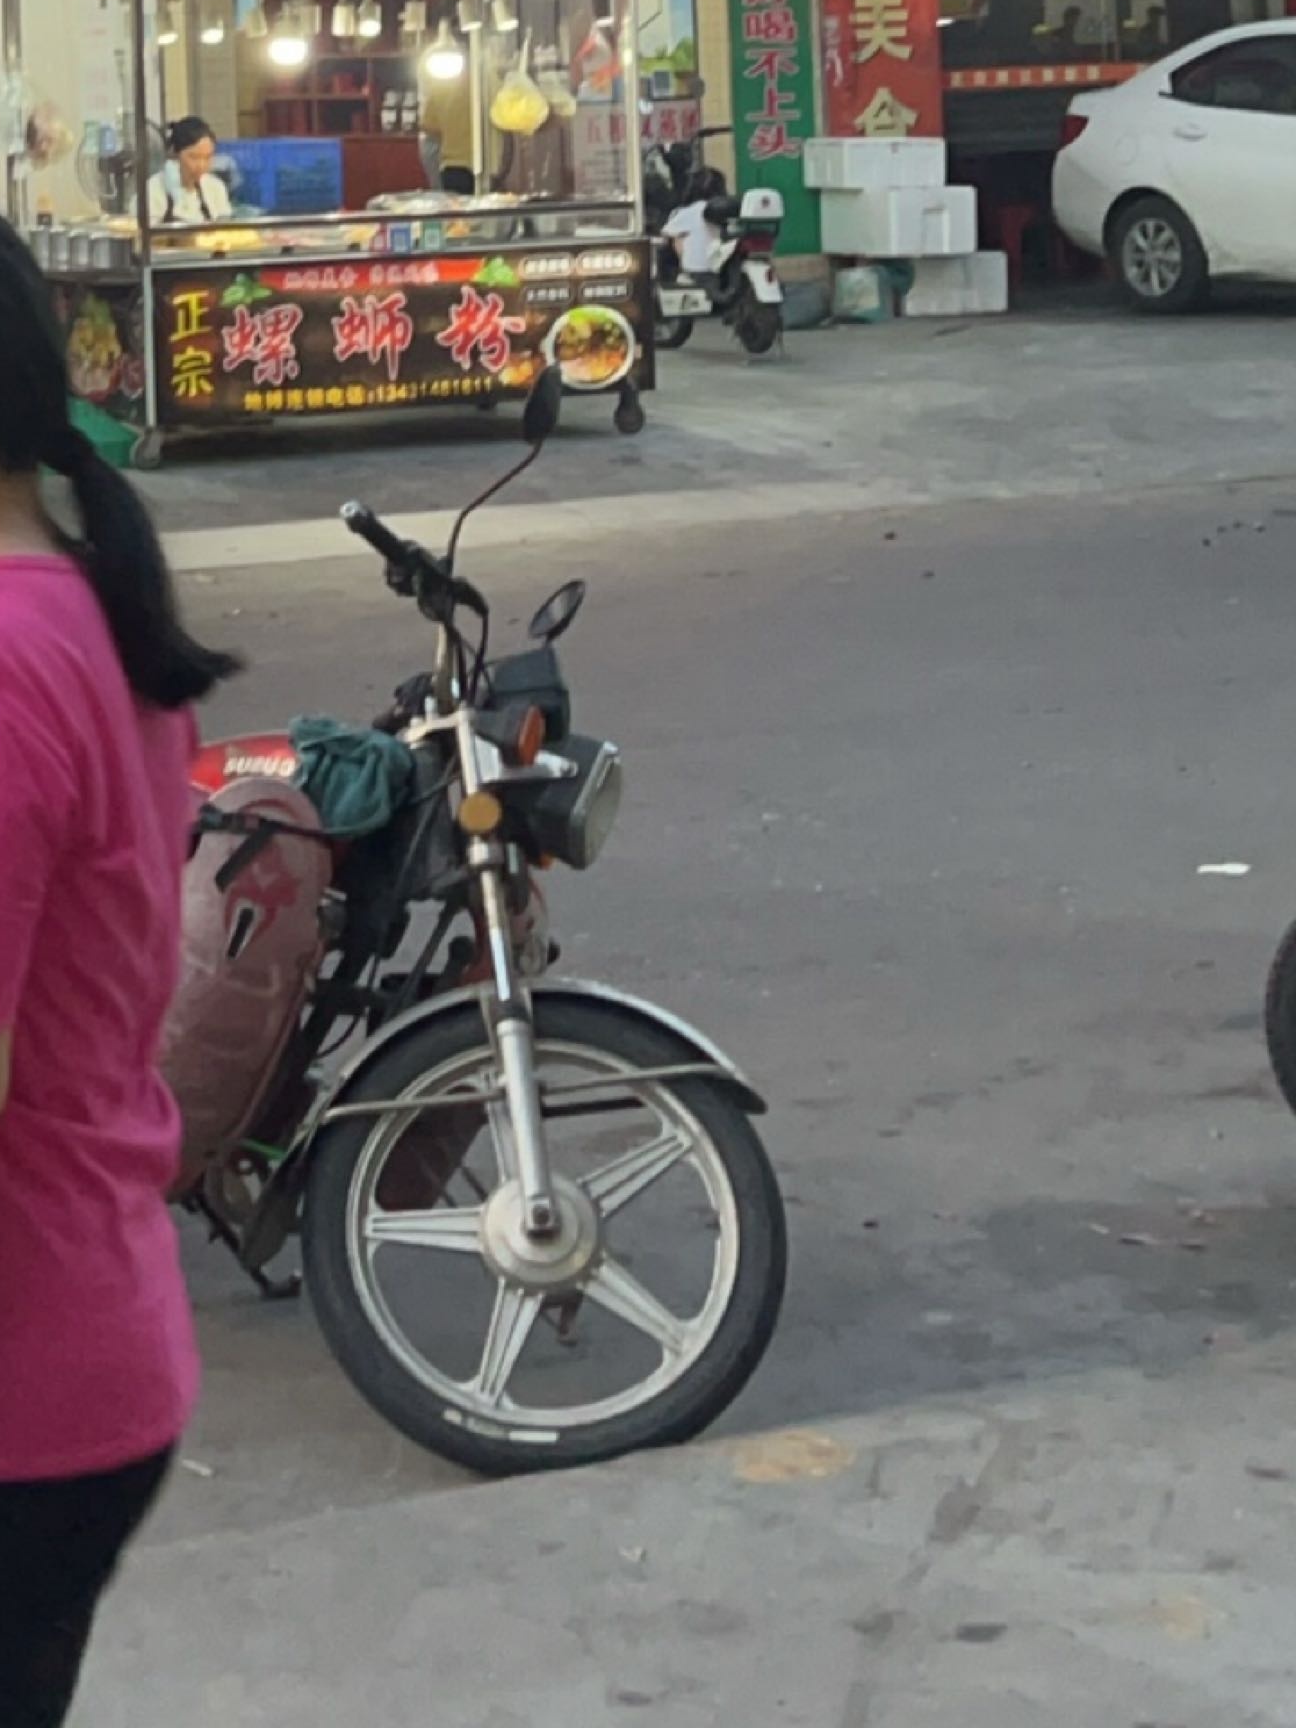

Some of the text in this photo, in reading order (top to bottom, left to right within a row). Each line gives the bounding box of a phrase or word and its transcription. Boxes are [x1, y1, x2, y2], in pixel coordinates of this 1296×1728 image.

[170, 288, 214, 398] 正宗
[220, 285, 527, 386] 螺蛳粉
